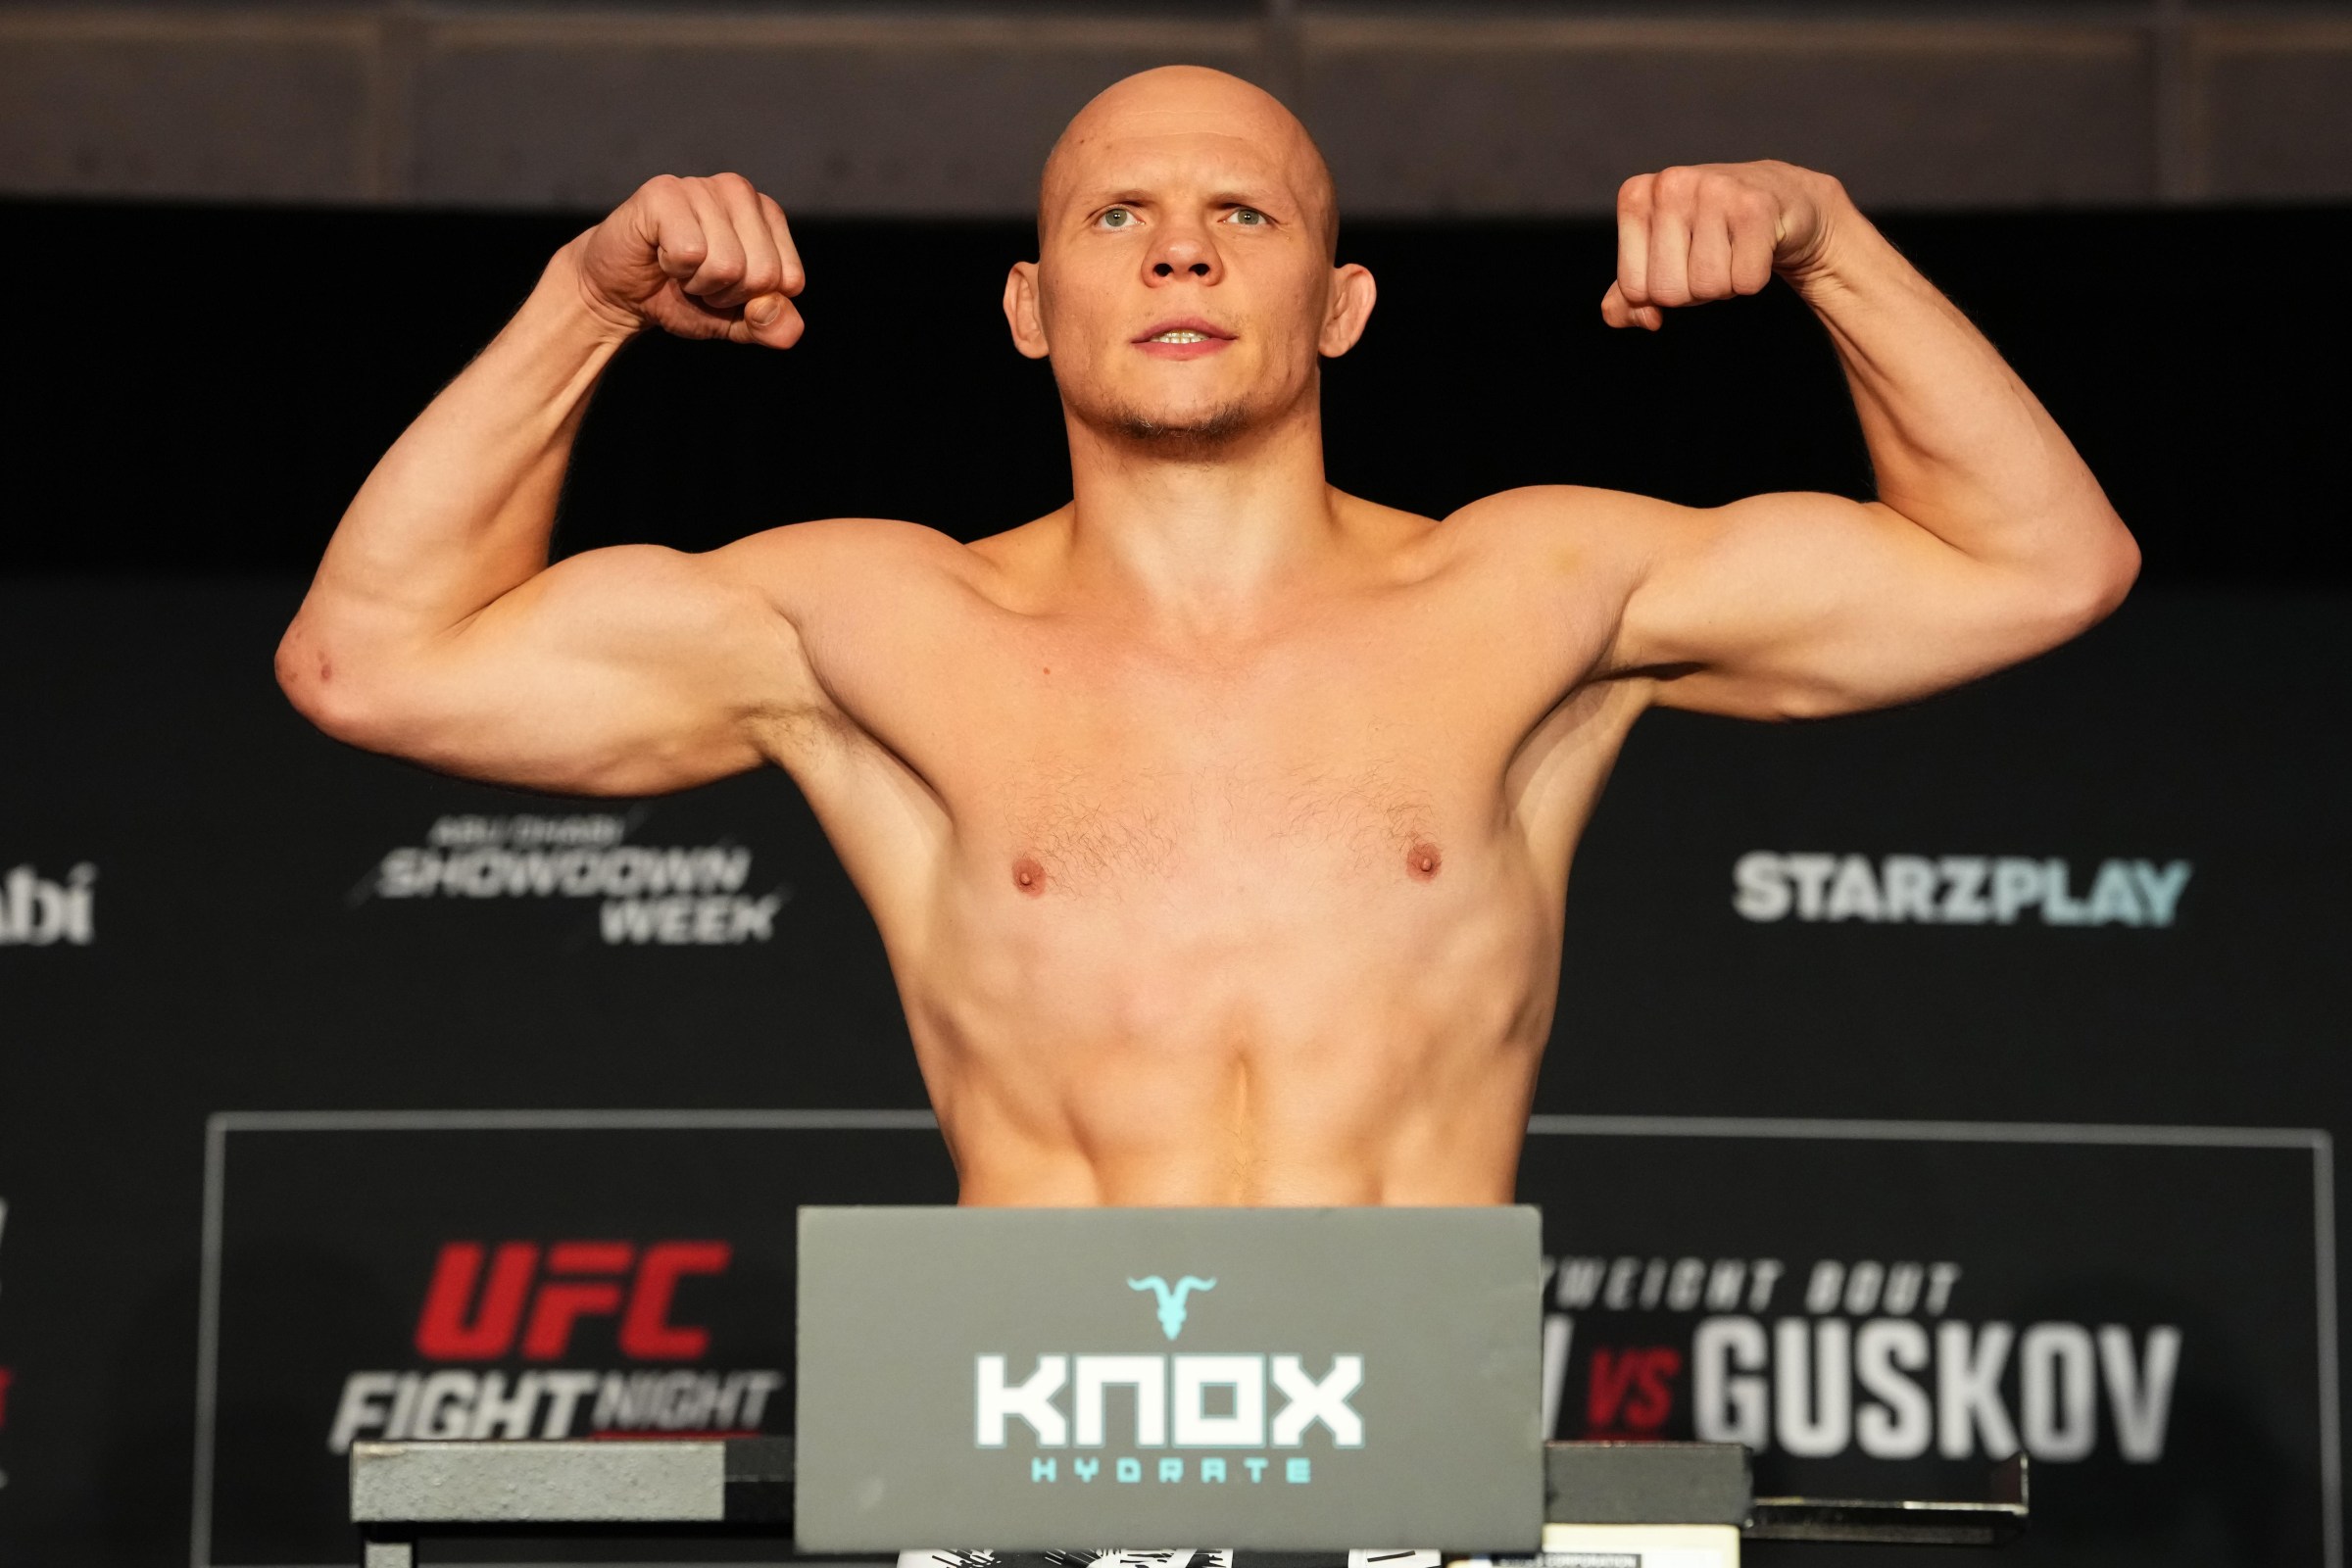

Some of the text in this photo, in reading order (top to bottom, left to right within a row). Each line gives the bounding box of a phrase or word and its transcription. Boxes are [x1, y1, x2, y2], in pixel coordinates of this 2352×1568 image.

[427, 814, 625, 846] ABU DHABI
[377, 847, 753, 899] SHOWDOWN
[1732, 849, 2192, 927] STARZPLAY
[599, 893, 784, 944] WEEK
[415, 1241, 733, 1360] UFC
[1805, 1259, 1960, 1315] BOUT
[327, 1372, 782, 1454] FIGHT NIGHT
[975, 1352, 1365, 1448] KNOX
[1586, 1345, 1683, 1431] VS
[1691, 1315, 2183, 1464] GUSKOV
[1031, 1457, 1311, 1484] HYDRATE
